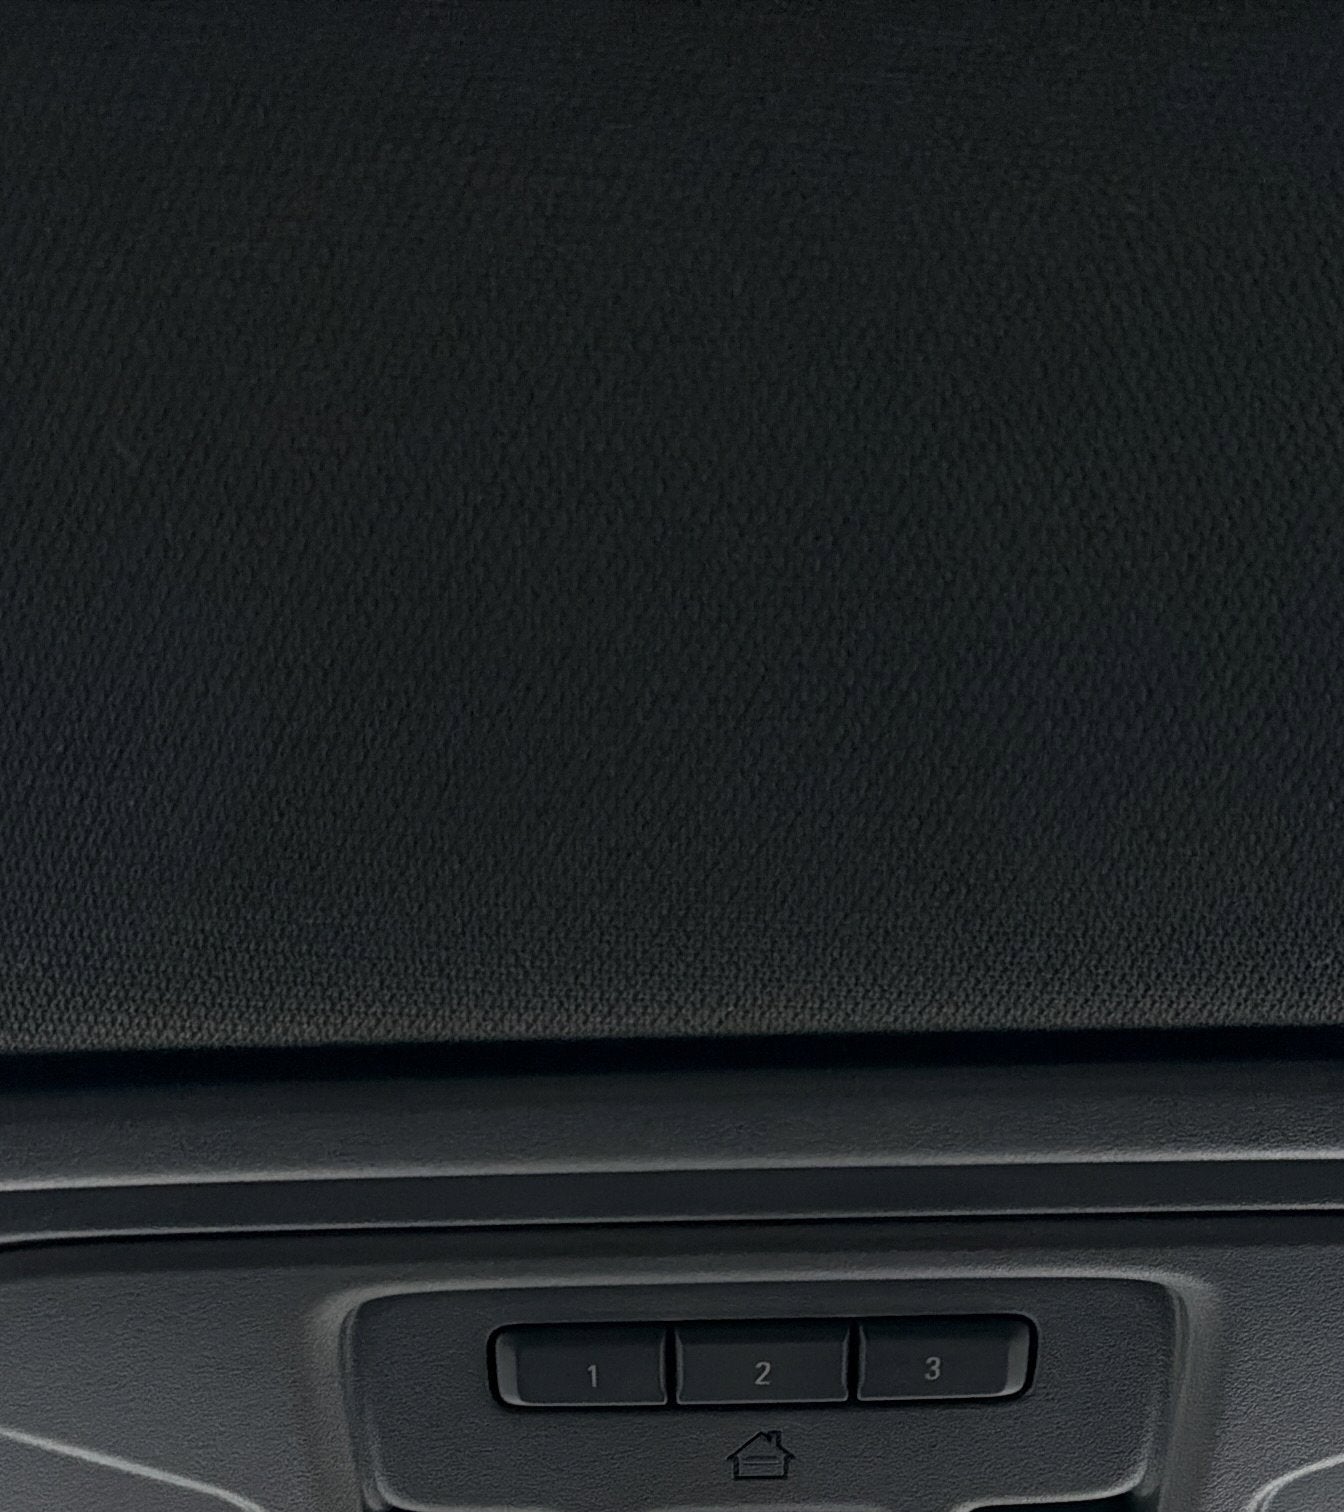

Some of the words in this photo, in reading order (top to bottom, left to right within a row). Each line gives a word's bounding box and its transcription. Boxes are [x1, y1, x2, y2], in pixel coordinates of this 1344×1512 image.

[587, 1364, 598, 1388] 1
[754, 1362, 772, 1385] 2
[925, 1356, 941, 1380] 3
